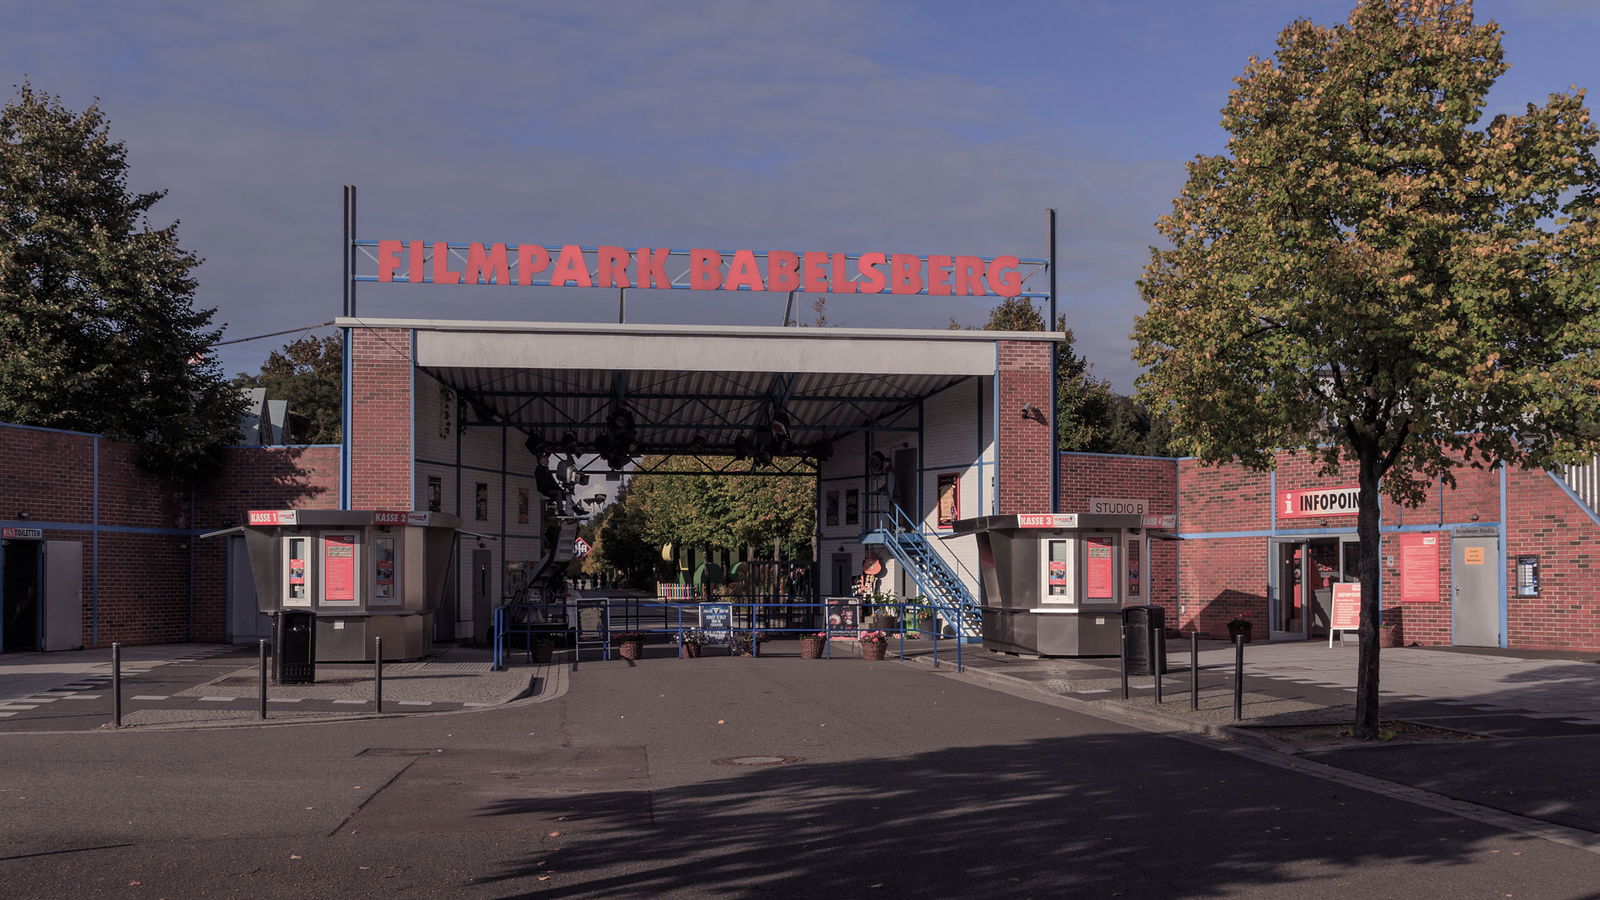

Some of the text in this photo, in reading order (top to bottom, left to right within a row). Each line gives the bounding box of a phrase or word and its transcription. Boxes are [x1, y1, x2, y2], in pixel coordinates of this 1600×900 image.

[378, 240, 1022, 297] FILMPARK BABELSBERG
[1300, 492, 1360, 511] INFOPOIN
[1095, 502, 1144, 513] STUDIO B
[251, 513, 271, 522] KASSE
[375, 513, 399, 522] KASSE
[400, 513, 406, 522] 2
[1021, 517, 1044, 525] KASSE
[1046, 517, 1052, 525] 3
[15, 529, 41, 537] TOILETTEN
